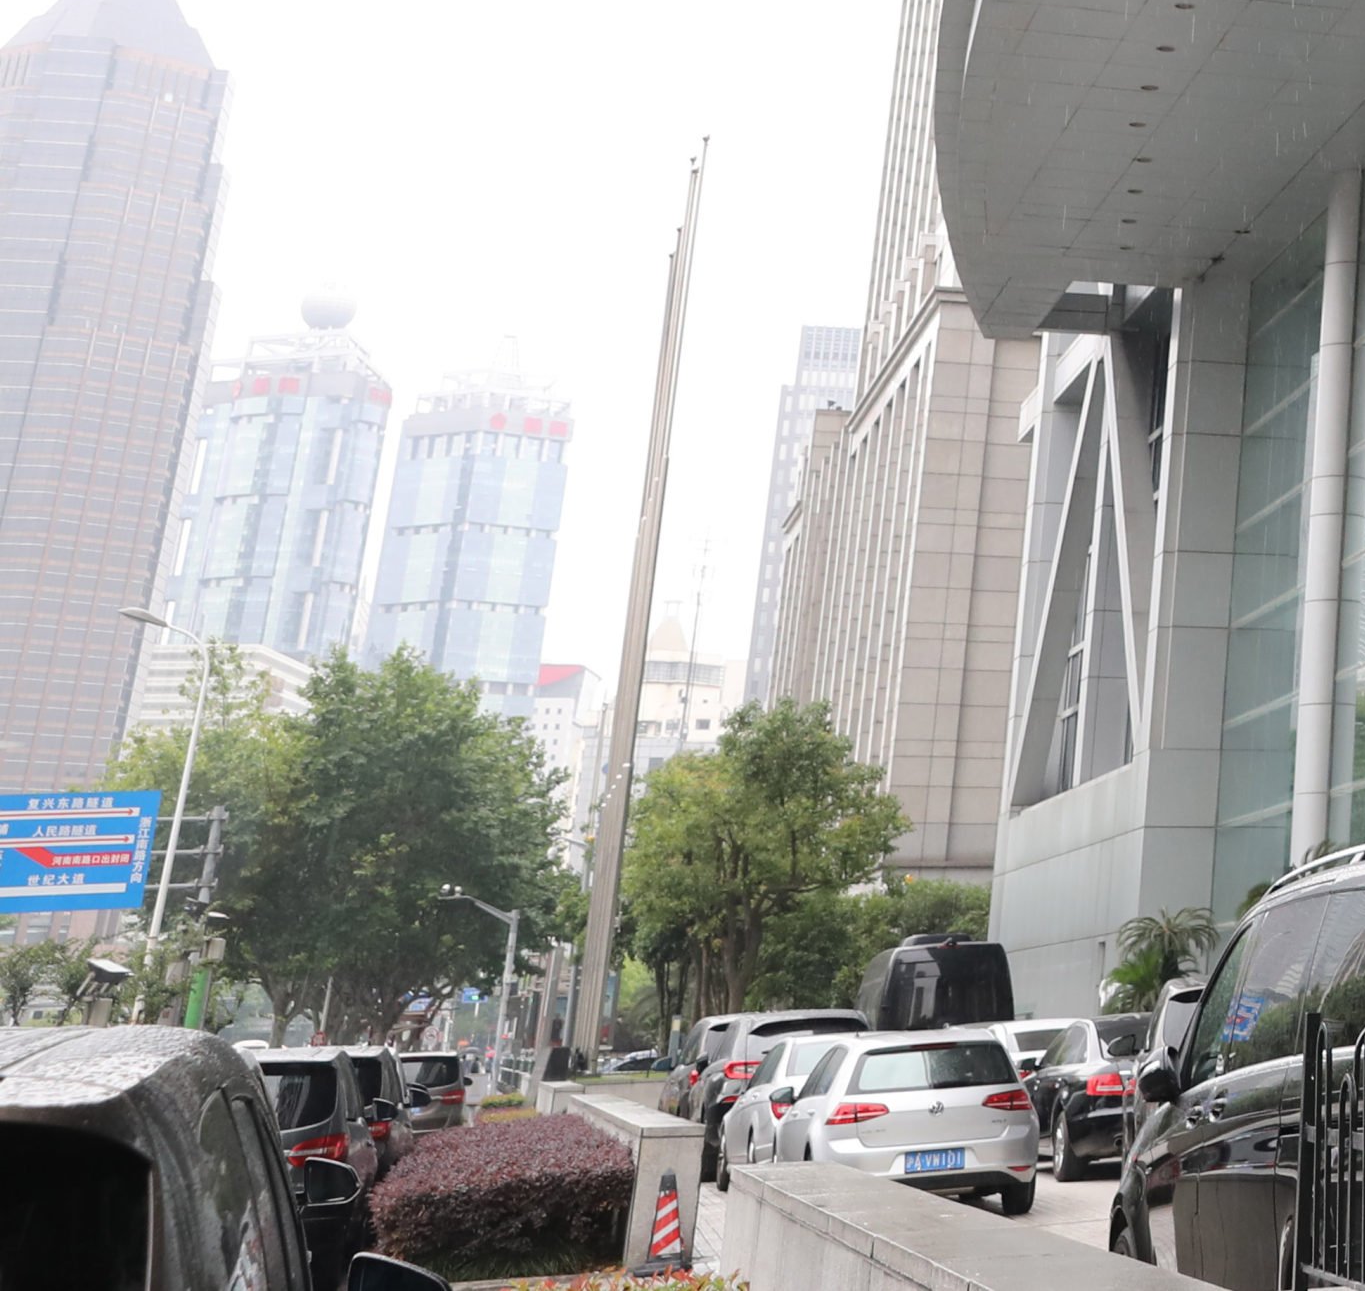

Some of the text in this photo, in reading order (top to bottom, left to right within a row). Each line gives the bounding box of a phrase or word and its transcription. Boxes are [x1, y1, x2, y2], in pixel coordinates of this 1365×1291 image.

[27, 797, 114, 810] 复兴东路隧道
[32, 824, 97, 837] 人民路隧道
[27, 873, 85, 886] 世纪大道
